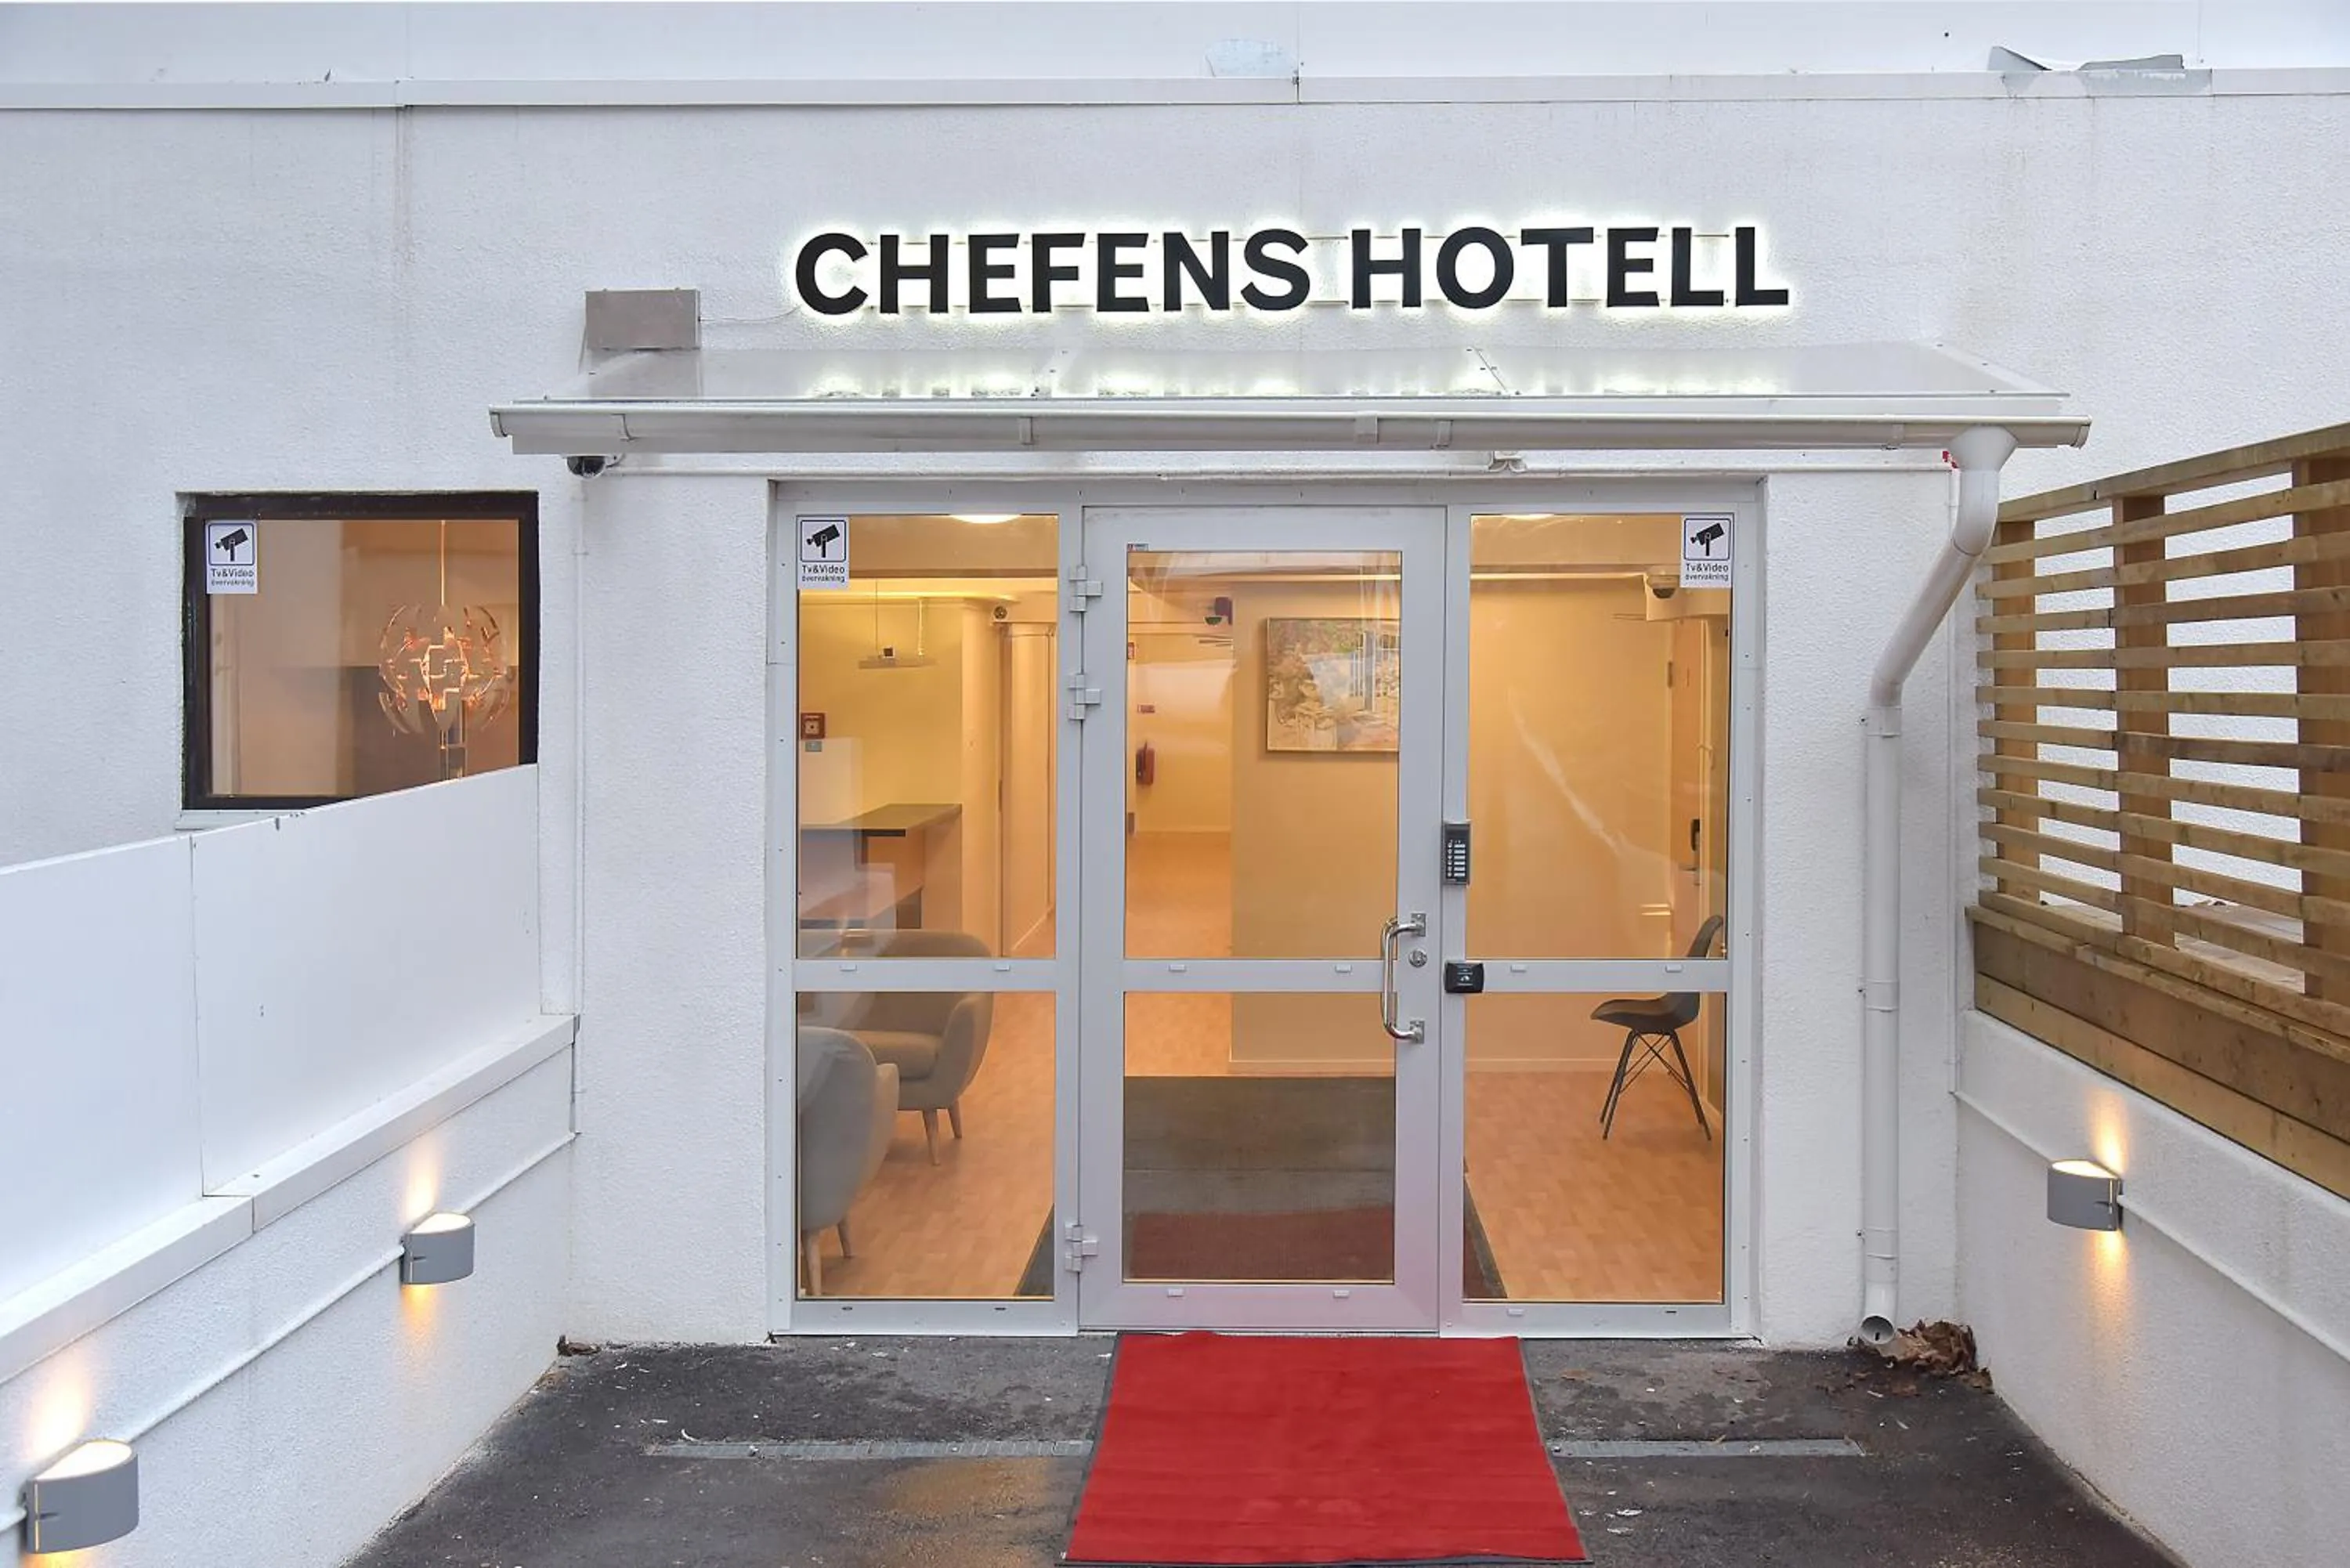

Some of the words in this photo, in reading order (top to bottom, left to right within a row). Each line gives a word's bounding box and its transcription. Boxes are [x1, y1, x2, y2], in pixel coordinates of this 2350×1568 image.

[795, 229, 1311, 315] CHEFENS
[1351, 226, 1788, 309] HOTELL
[211, 568, 254, 577] Tv&Video
[801, 564, 845, 573] Tv&Video
[1686, 563, 1729, 573] Tv&Video
